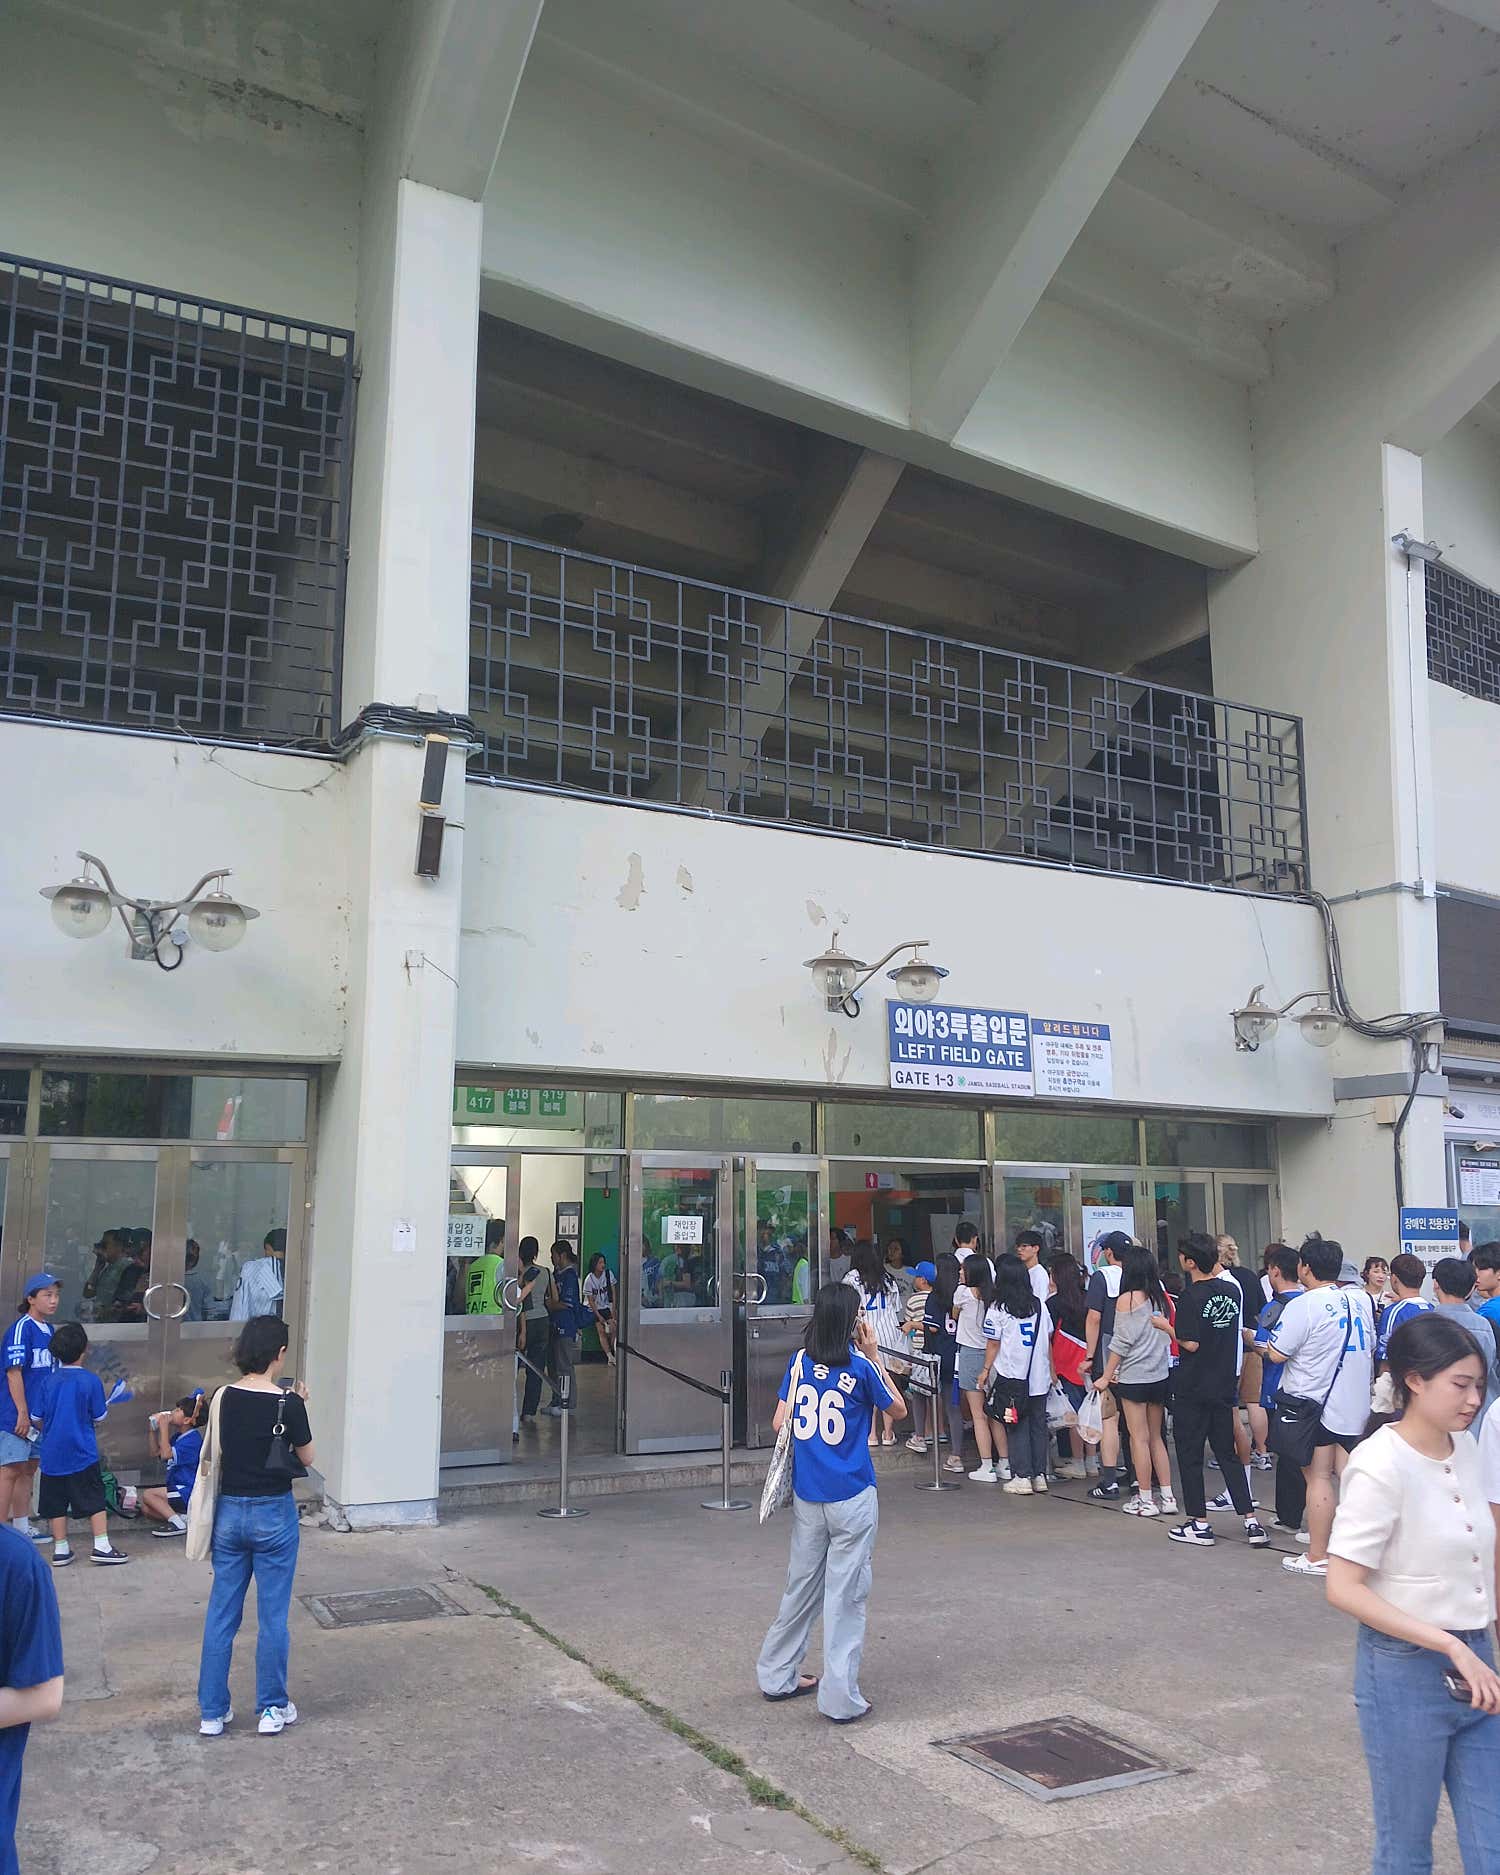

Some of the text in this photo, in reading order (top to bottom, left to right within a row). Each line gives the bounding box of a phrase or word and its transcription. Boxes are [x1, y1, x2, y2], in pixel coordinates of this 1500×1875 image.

[895, 1007, 1027, 1046] 외야3루출입문
[898, 1042, 1025, 1067] LEFT FIELD GATE
[895, 1070, 954, 1087] GATE 1-3
[507, 1087, 529, 1099] 418
[469, 1097, 492, 1109] 417
[674, 1220, 697, 1230] 재입장
[1404, 1216, 1457, 1231] 장애인 전용창구
[674, 1231, 696, 1241] 출입구
[1019, 1322, 1034, 1347] 5
[793, 1383, 846, 1446] 36
